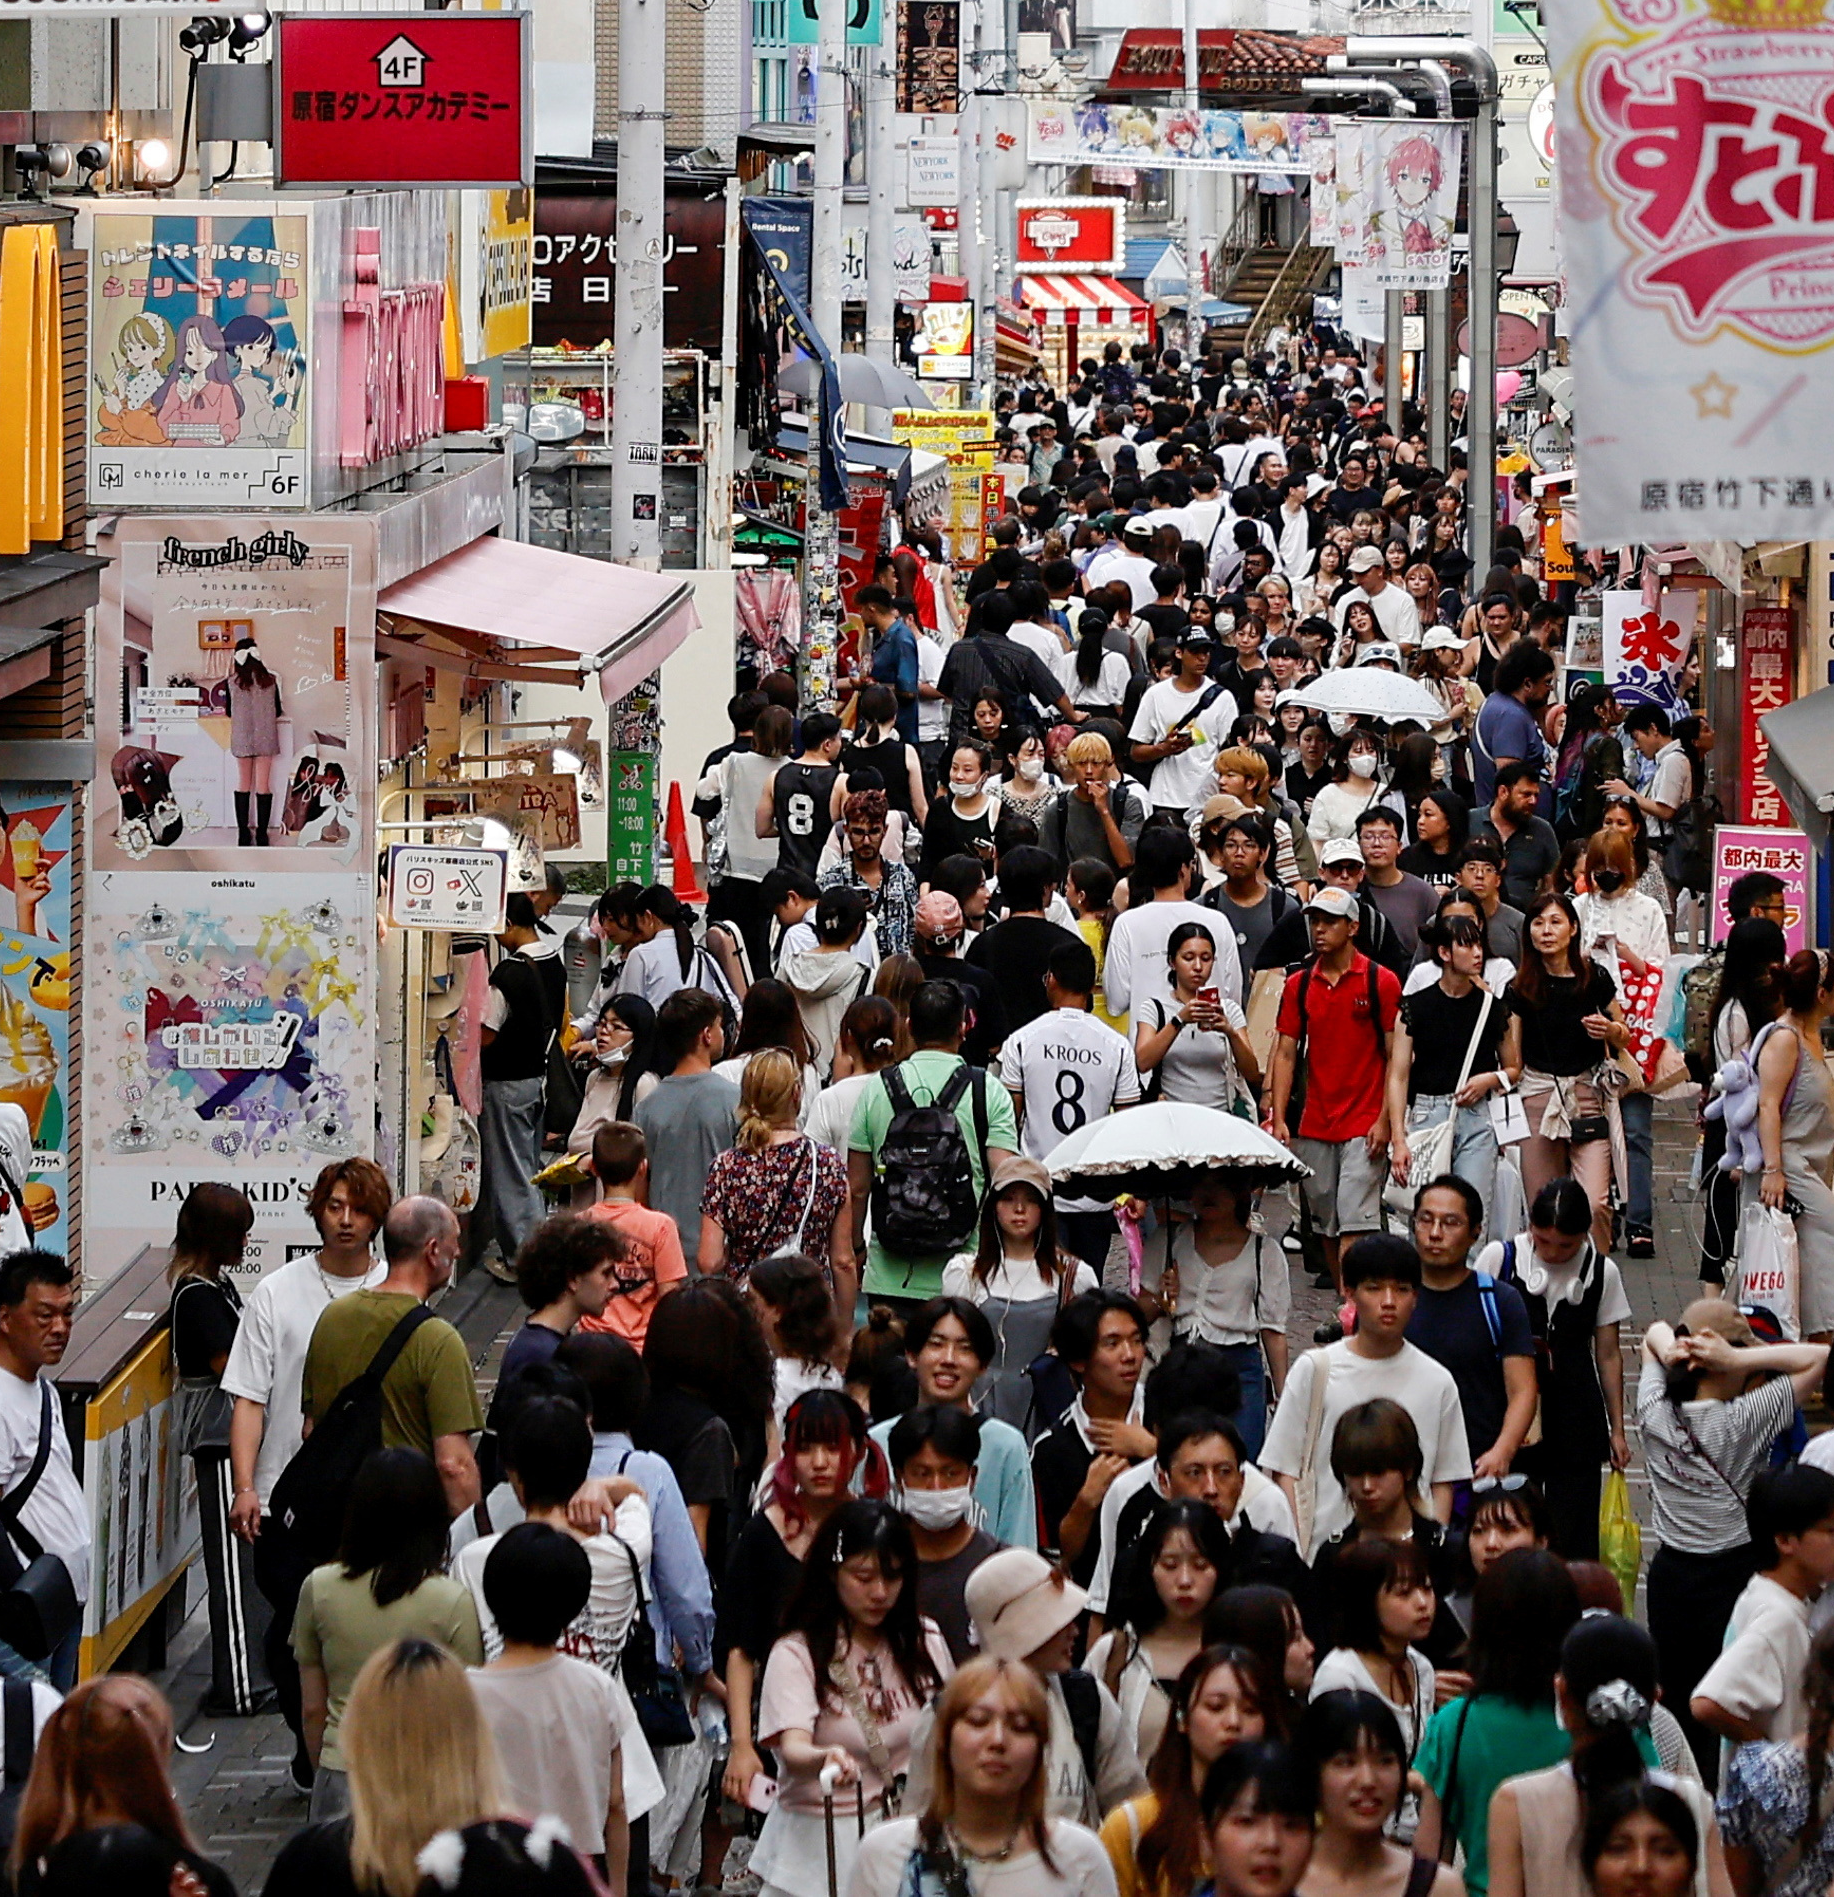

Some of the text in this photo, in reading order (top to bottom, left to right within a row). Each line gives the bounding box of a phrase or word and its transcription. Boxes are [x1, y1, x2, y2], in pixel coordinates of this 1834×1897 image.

[383, 54, 418, 80] 4F
[291, 90, 511, 123] 原宿ダンスアカデミー
[196, 467, 211, 480] la
[219, 469, 250, 480] mer
[271, 475, 300, 495] 6F
[164, 530, 310, 568] french girly
[1619, 611, 1682, 672] 氷
[1745, 628, 1788, 650] 都内
[788, 792, 814, 835] 8
[1723, 845, 1805, 871] 都内最大
[211, 878, 256, 888] oshikatu
[200, 999, 263, 1009] OSHIKATU
[1043, 1044, 1103, 1066] KROOS
[1052, 1069, 1086, 1136] 8
